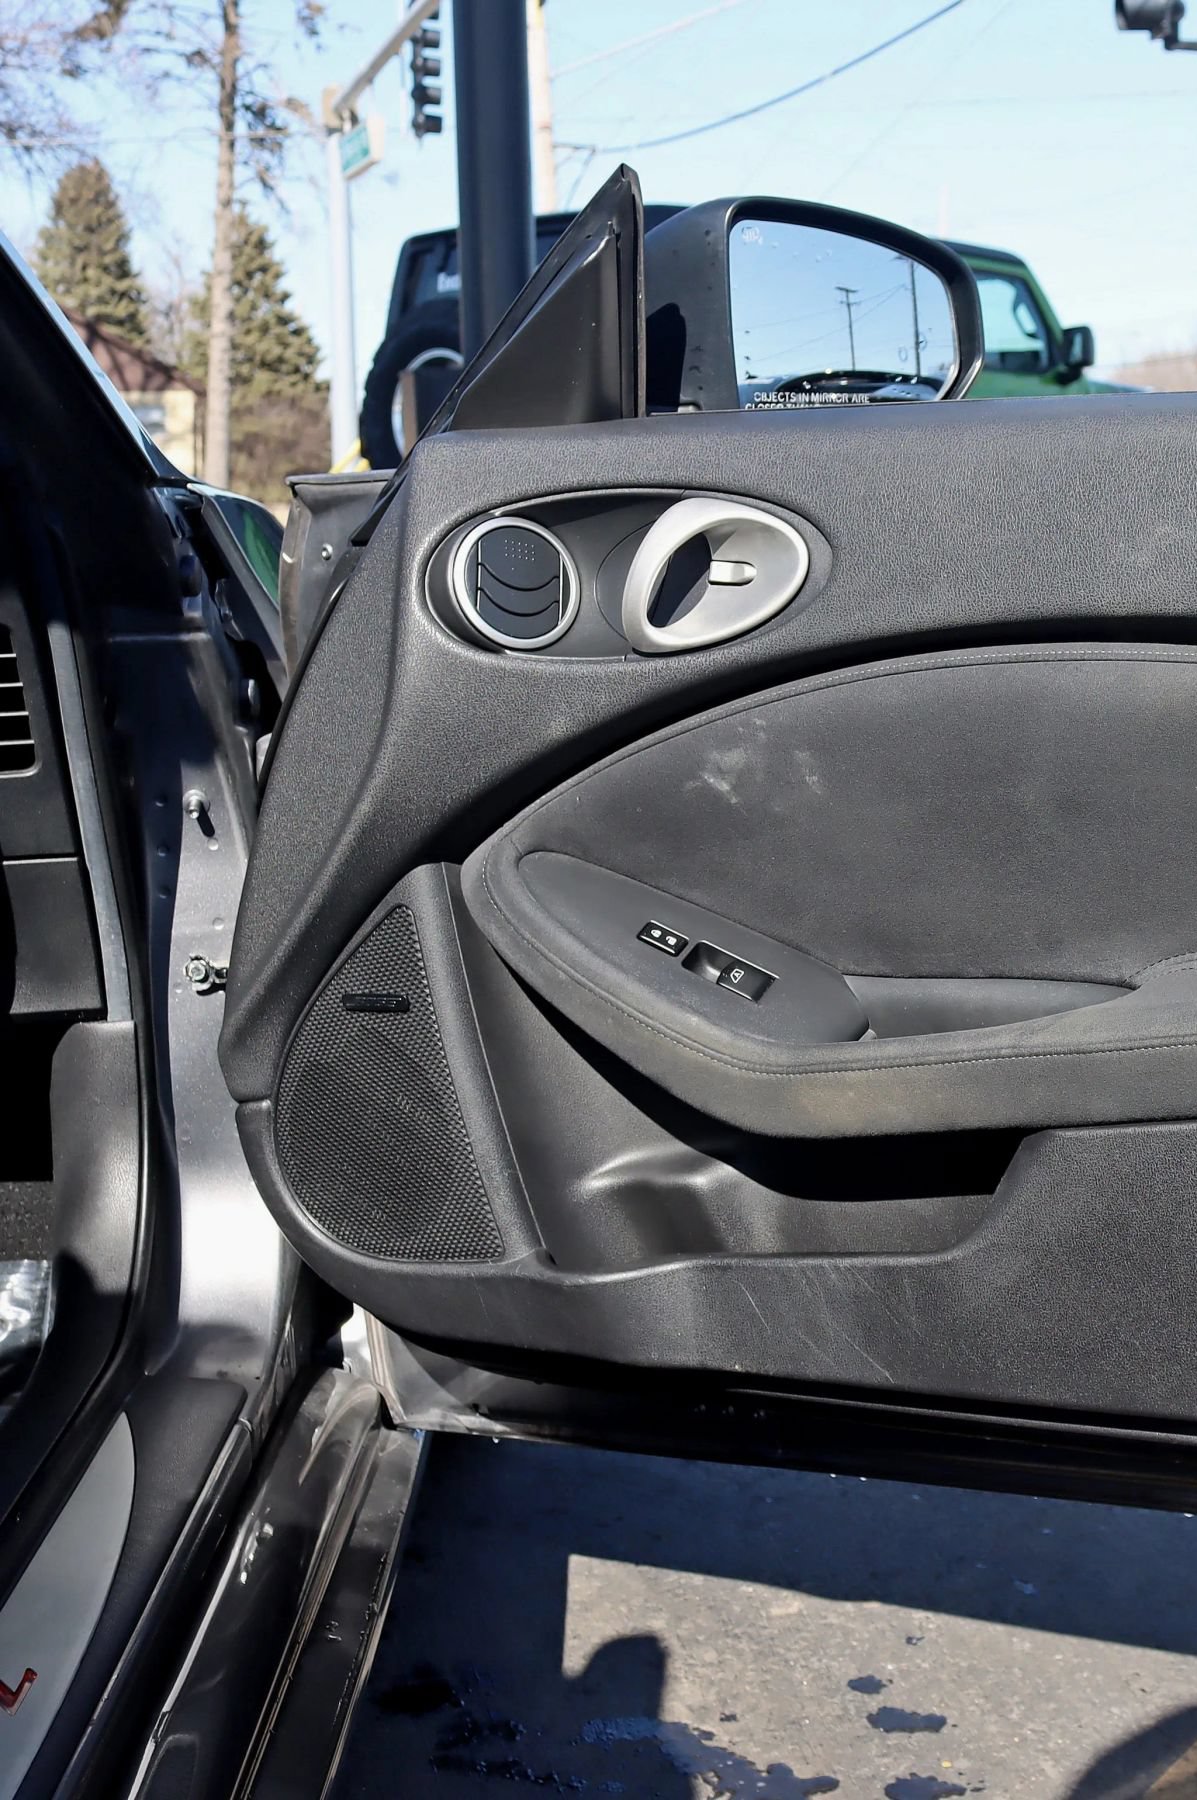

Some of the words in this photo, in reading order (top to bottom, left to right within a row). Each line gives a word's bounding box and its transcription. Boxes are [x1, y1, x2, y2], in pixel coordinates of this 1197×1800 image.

[753, 391, 797, 403] OBJECTS
[798, 392, 810, 403] IN
[811, 392, 849, 404] MIRROR
[851, 393, 871, 404] ARE
